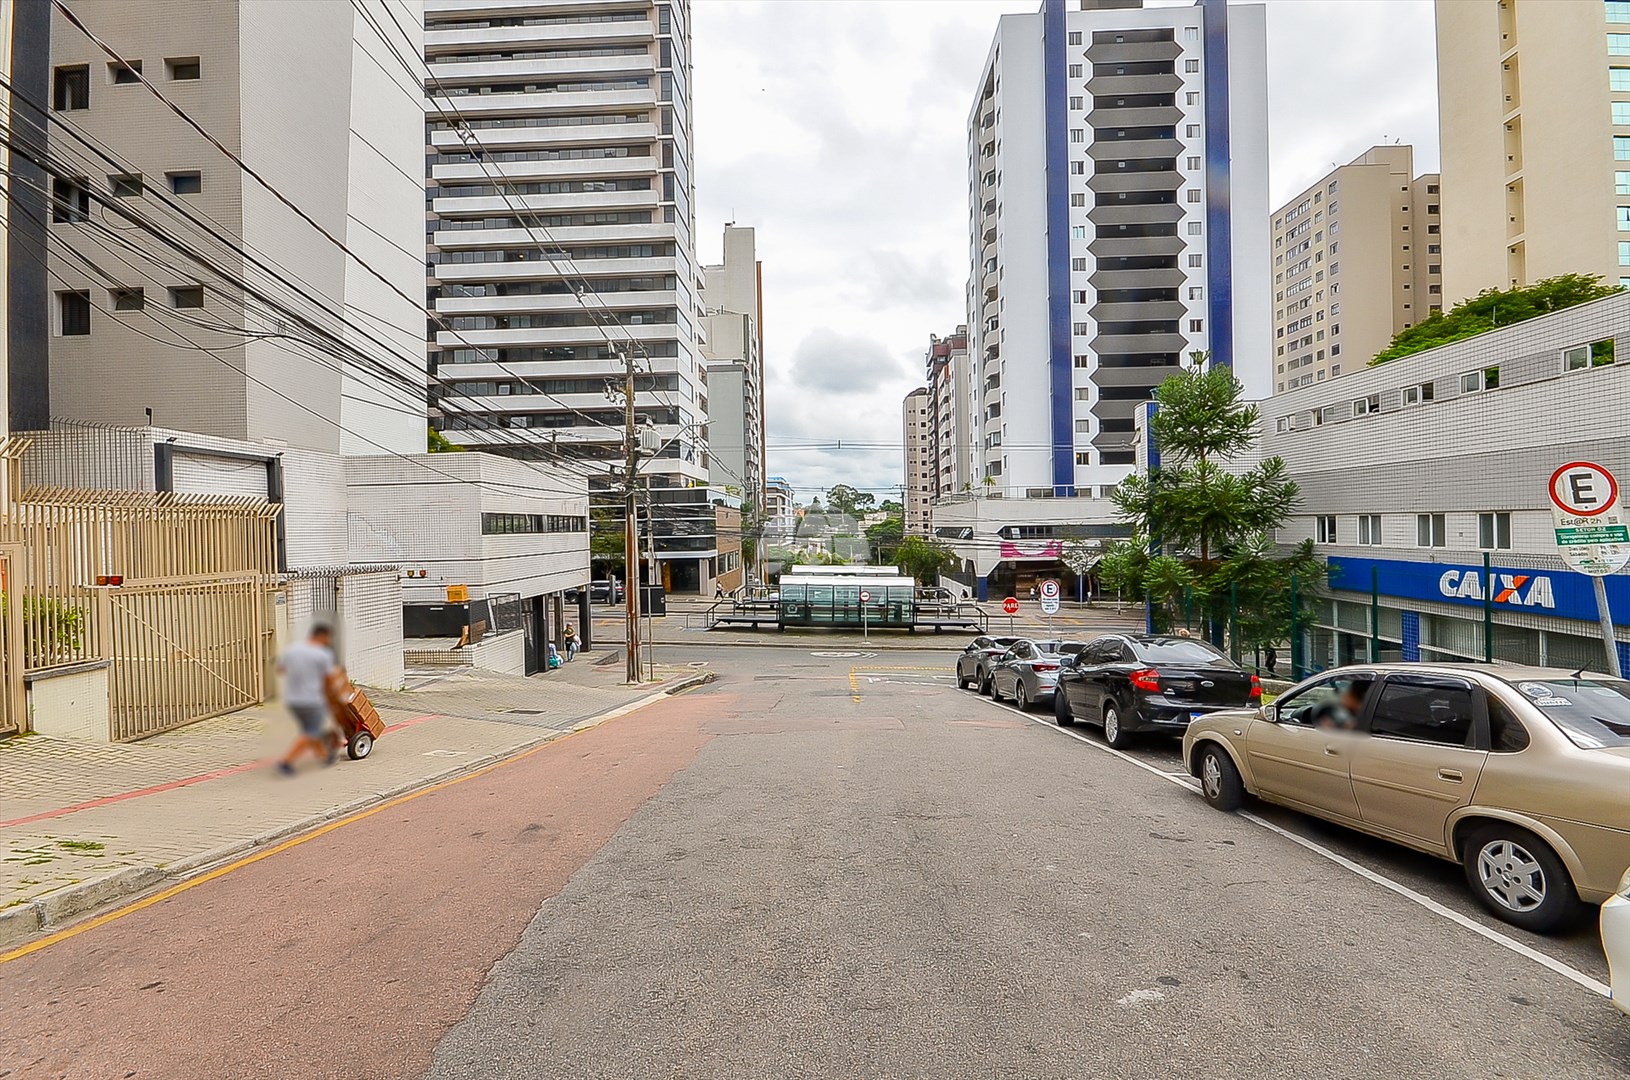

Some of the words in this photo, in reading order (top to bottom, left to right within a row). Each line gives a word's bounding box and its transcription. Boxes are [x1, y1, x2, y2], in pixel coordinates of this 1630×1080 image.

[1569, 473, 1597, 504] E
[1046, 584, 1053, 594] E
[1440, 569, 1556, 609] CAIXA
